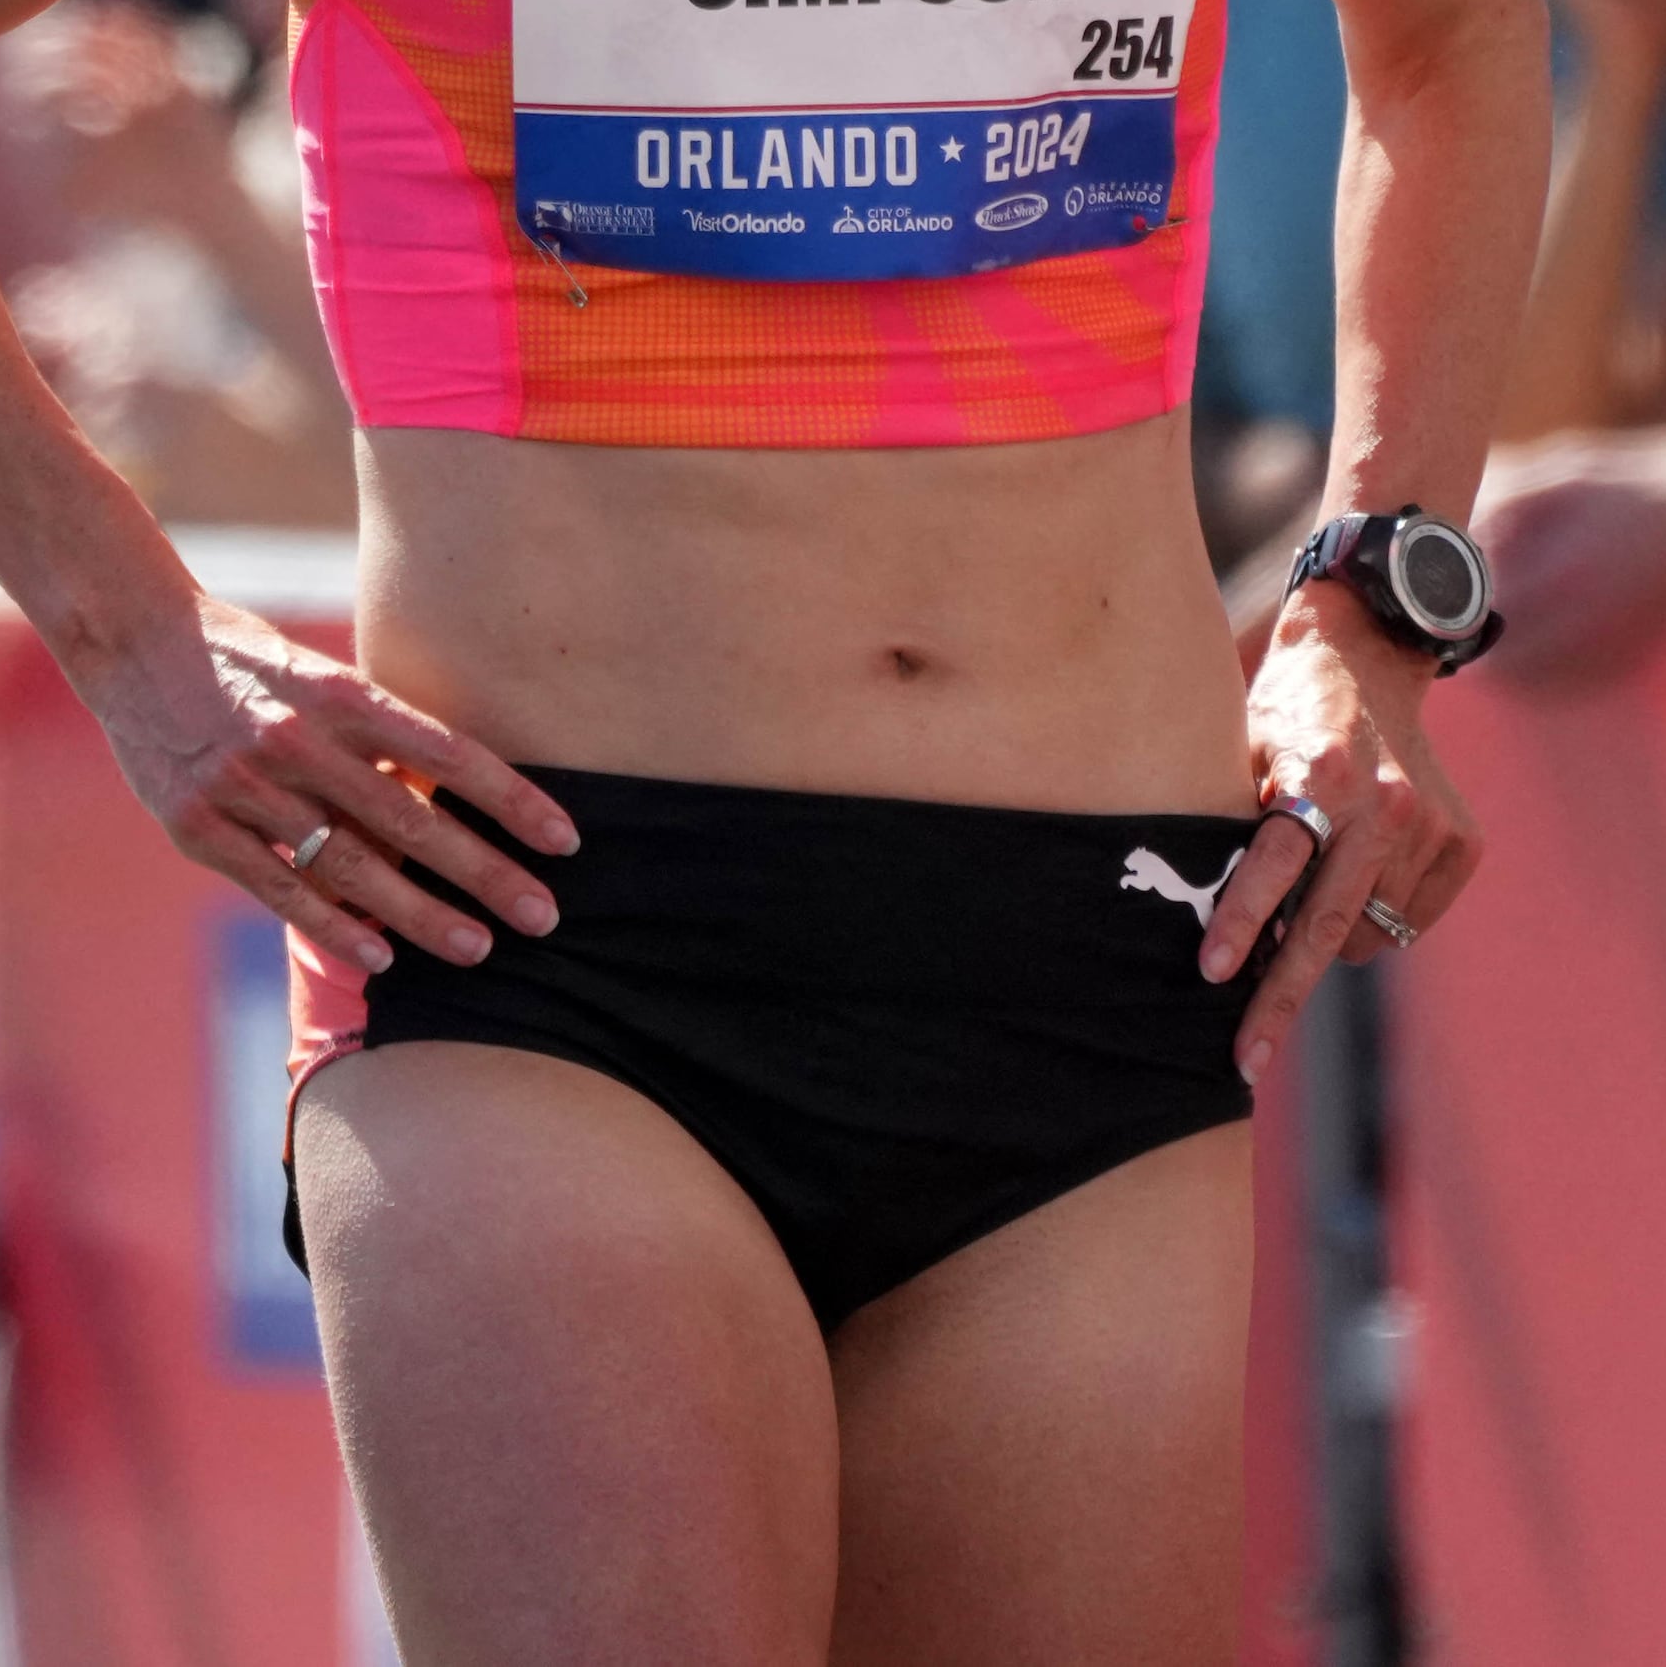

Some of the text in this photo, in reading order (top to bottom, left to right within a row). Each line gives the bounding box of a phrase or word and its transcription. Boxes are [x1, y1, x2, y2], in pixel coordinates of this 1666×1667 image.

[1072, 15, 1175, 81] 254
[637, 113, 1091, 191] ORLANDO 2024
[1087, 190, 1162, 205] ORLANDO
[867, 207, 912, 219] CITY OF
[867, 217, 953, 233] ORLANDO
